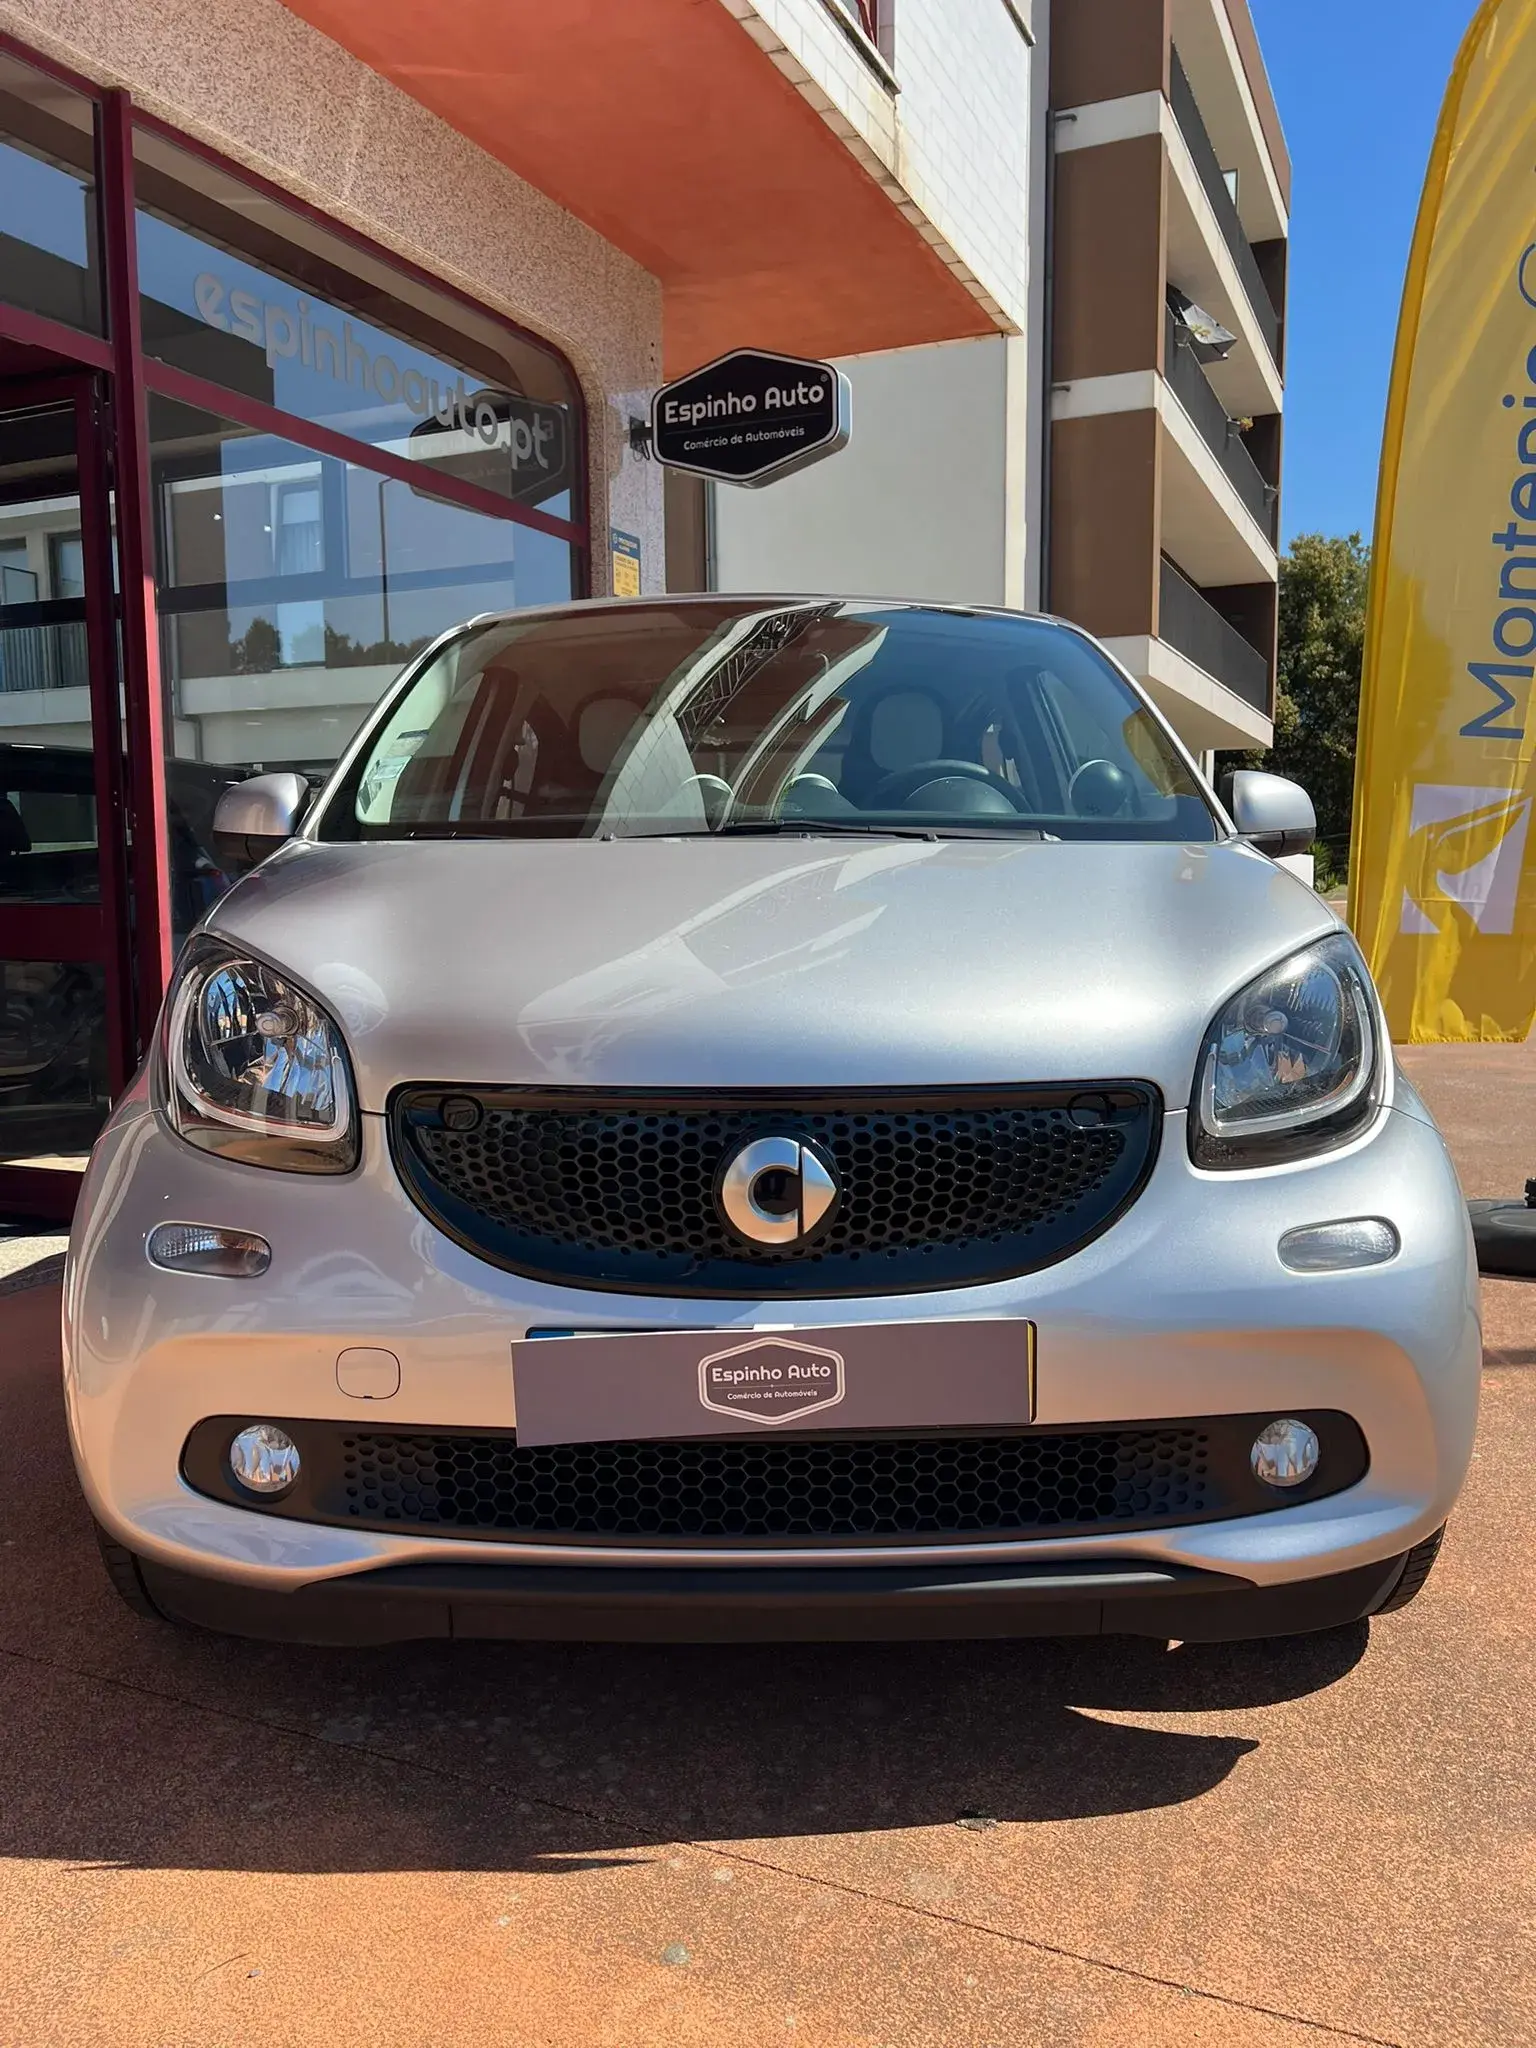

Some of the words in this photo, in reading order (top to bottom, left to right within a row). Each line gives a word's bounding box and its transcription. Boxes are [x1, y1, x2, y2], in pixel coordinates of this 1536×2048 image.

[193, 272, 549, 470] espinhoauto.pt
[664, 391, 756, 426] Espinho
[765, 381, 825, 410] Auto
[683, 433, 729, 451] Comércio
[731, 434, 744, 445] de
[745, 426, 805, 443] Automóveis
[1460, 342, 1536, 739] Montei
[712, 1366, 782, 1385] Espinho
[788, 1363, 831, 1378] Auto
[727, 1391, 762, 1400] Comércio
[763, 1390, 773, 1399] de
[774, 1389, 817, 1399] Automóveis
